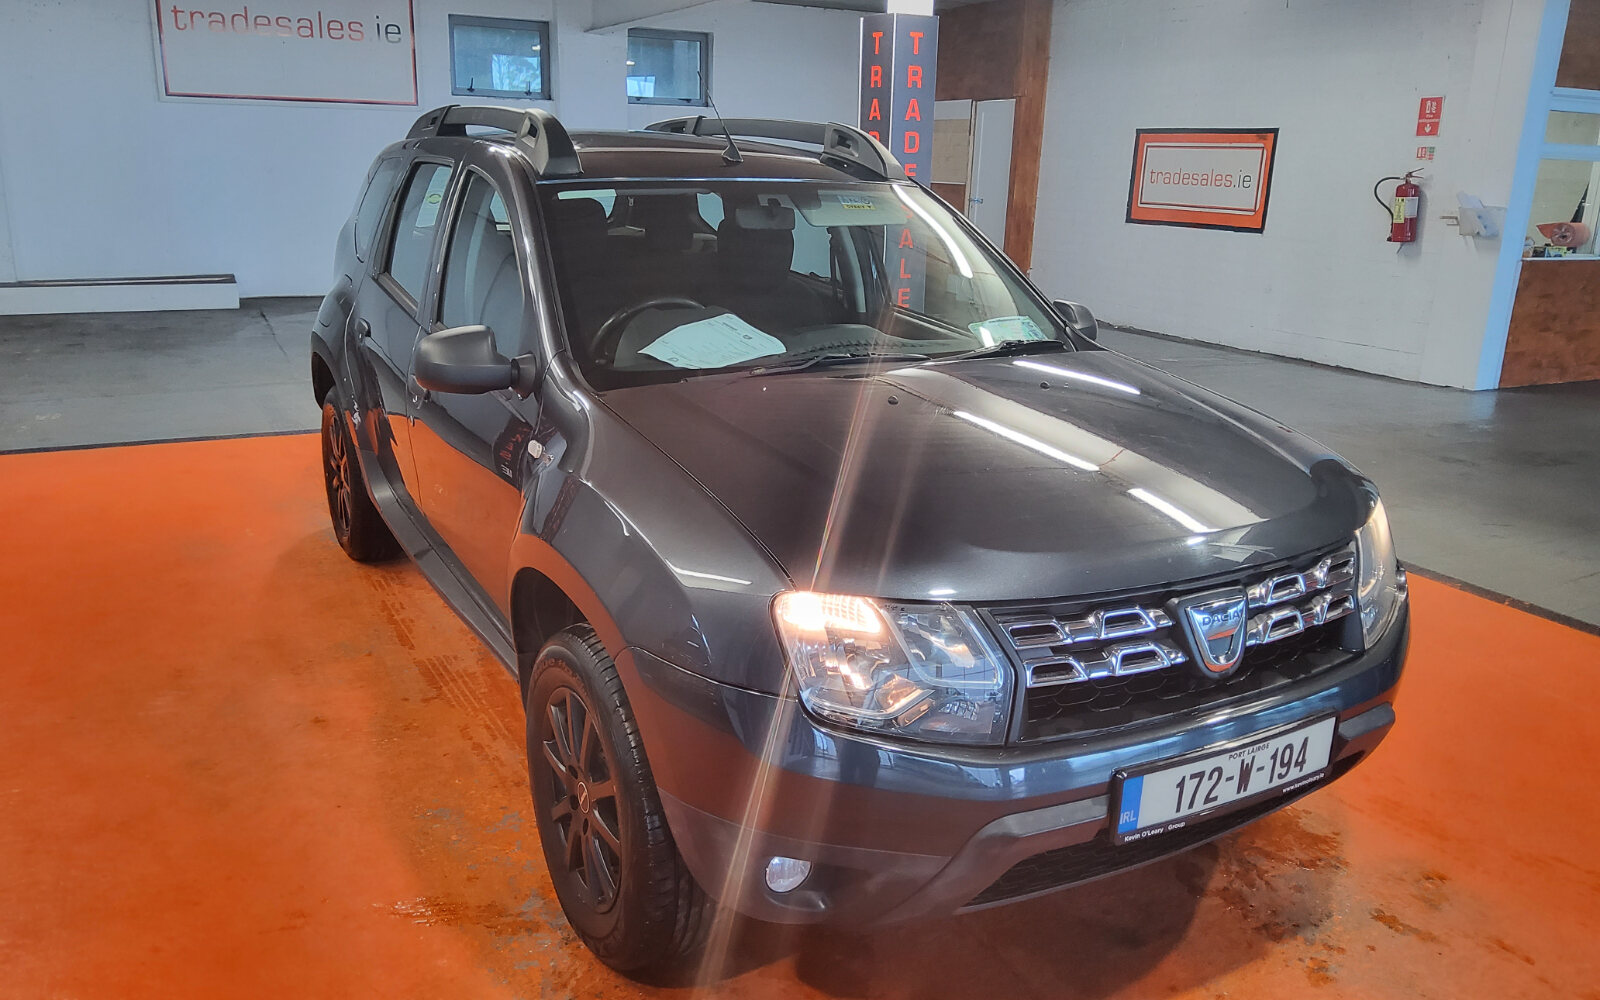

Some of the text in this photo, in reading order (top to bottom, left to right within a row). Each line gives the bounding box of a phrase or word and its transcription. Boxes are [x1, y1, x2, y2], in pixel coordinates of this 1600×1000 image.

[904, 31, 924, 177] TRADE
[1149, 167, 1252, 189] tradesales.ie
[1202, 610, 1241, 627] DACIA
[1175, 736, 1310, 814] 172-W-194
[1119, 810, 1137, 825] IRL
[1124, 833, 1141, 842] Kevin
[1167, 821, 1186, 831] Group
